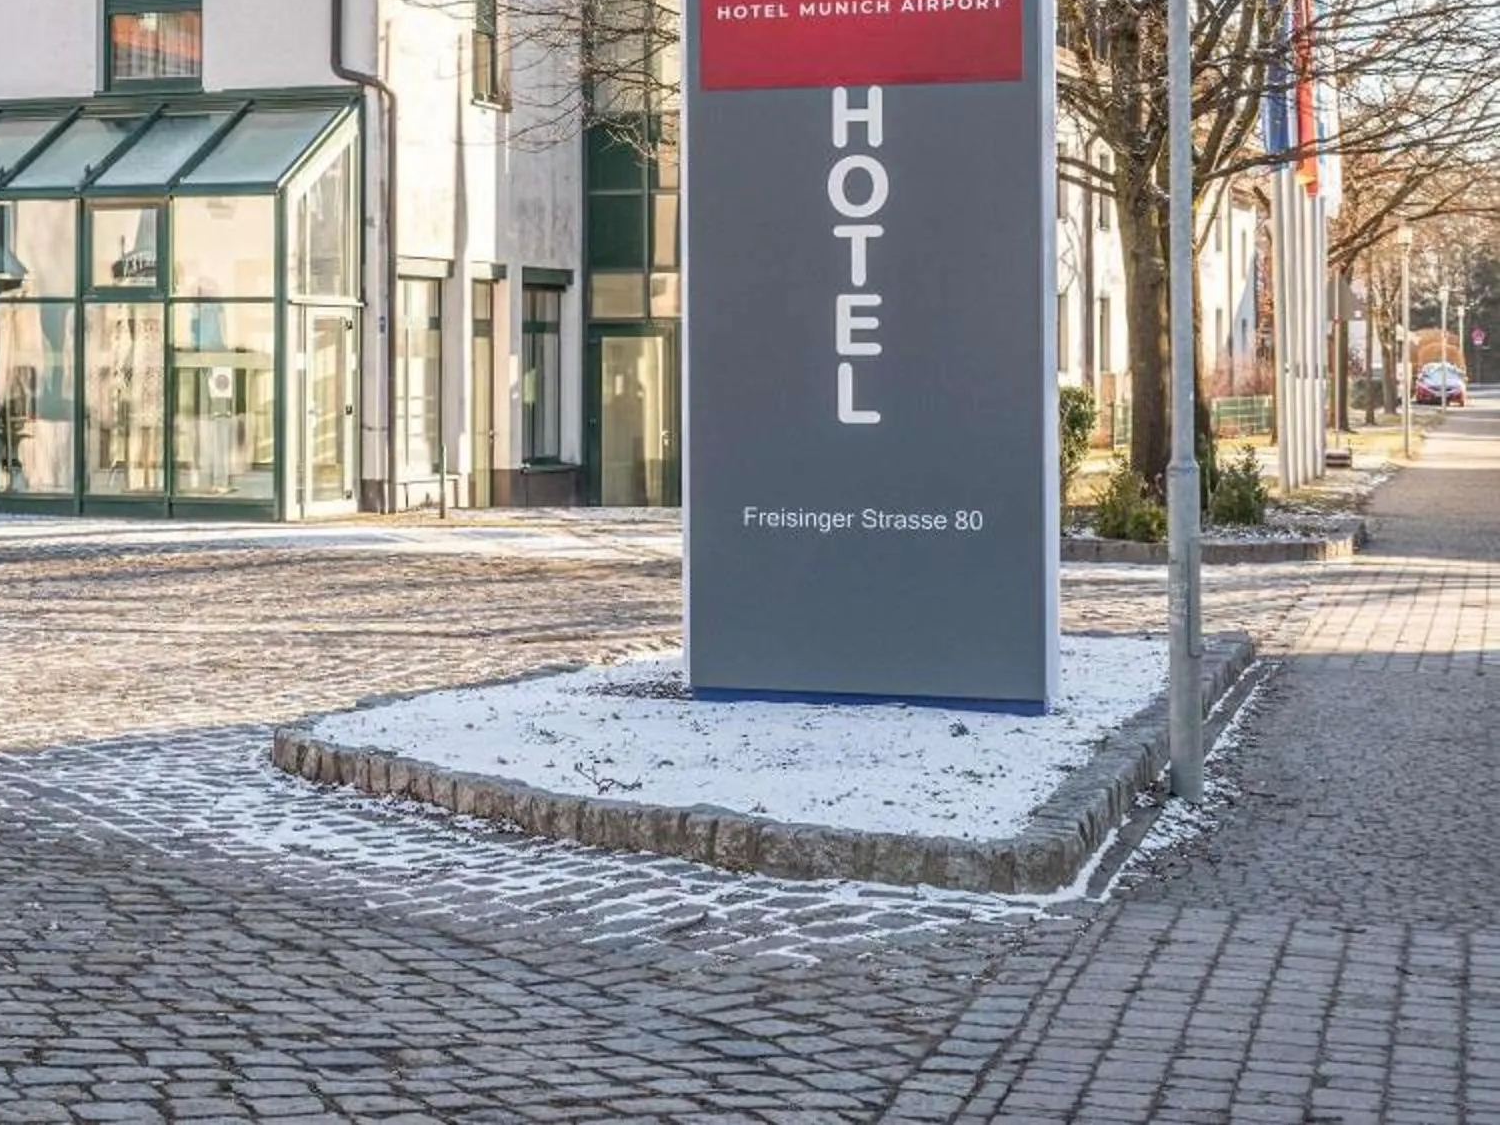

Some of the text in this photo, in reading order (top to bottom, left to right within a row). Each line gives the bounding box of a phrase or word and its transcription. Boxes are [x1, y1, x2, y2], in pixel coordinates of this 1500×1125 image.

[717, 2, 789, 20] HOTEL
[799, 0, 890, 17] MUNICH
[827, 85, 889, 424] HOTEL
[743, 506, 983, 533] Freisinger Strasse 80
